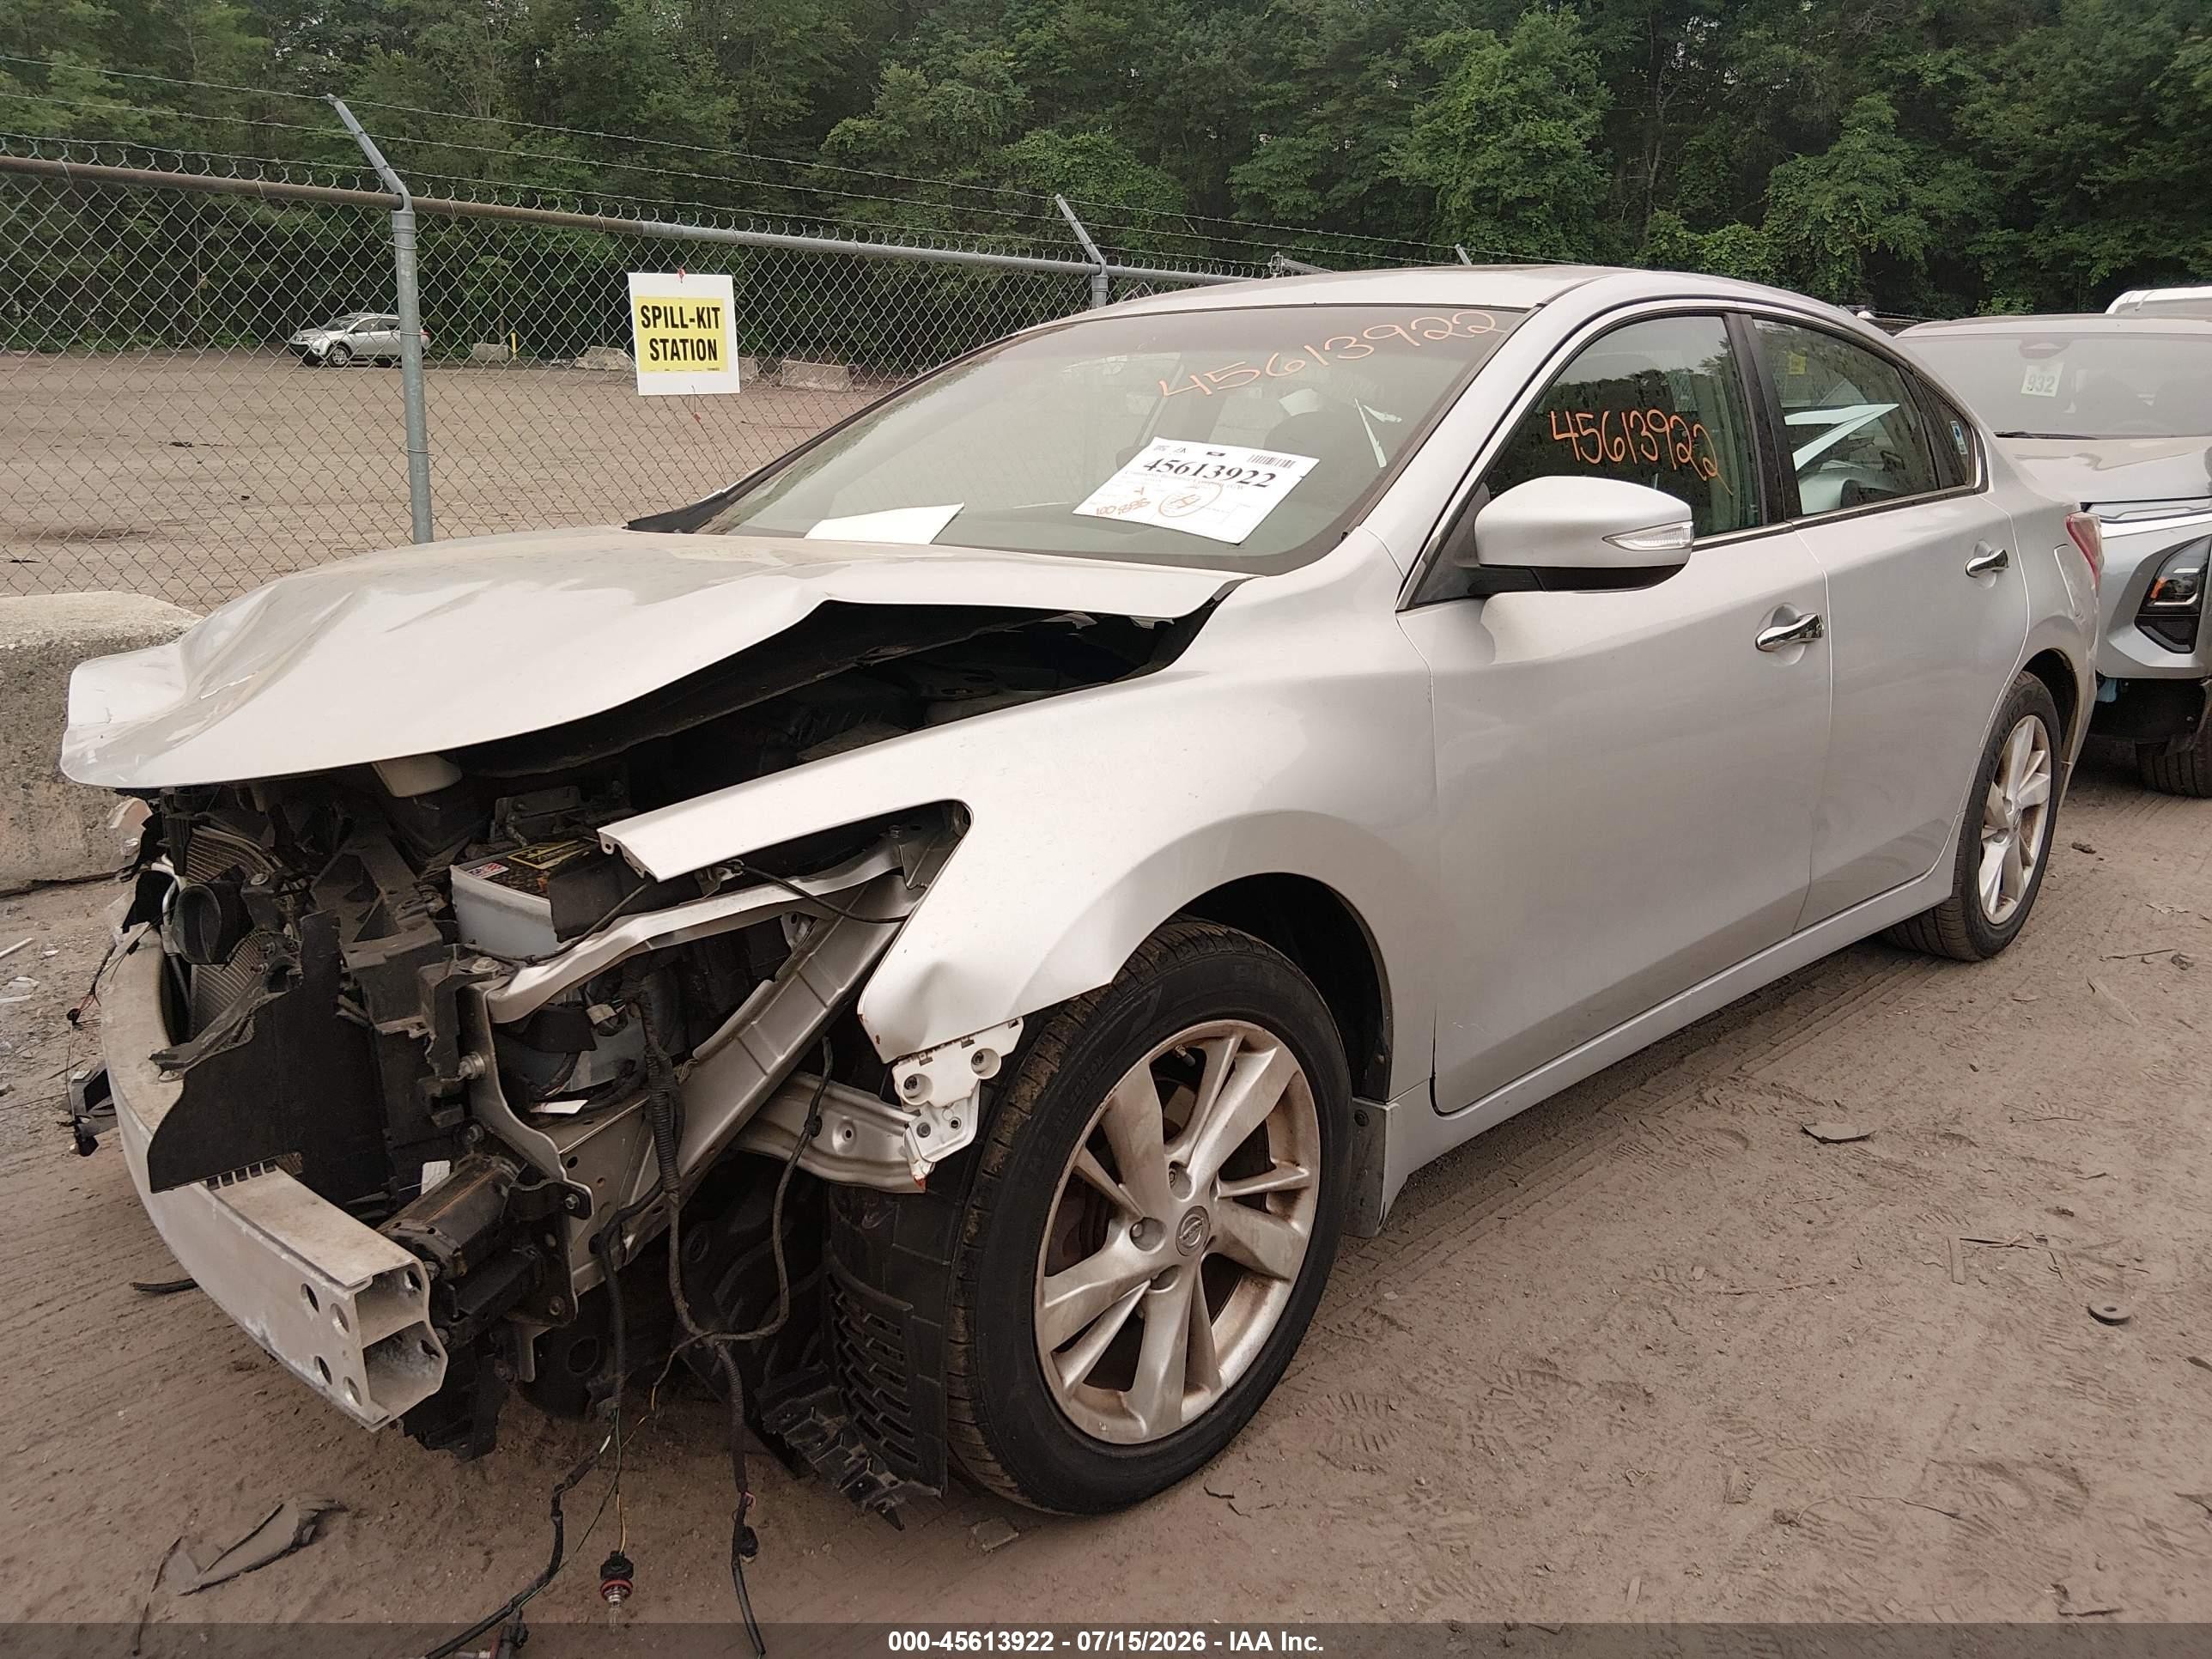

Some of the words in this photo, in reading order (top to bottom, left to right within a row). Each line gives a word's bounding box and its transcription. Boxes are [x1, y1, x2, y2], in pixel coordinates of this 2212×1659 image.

[640, 304, 720, 329] SPILL-KIT
[649, 337, 718, 362] STATION
[1158, 310, 1507, 398] 45613922
[1549, 408, 1734, 496] 45613922
[1143, 457, 1277, 489] 45613922
